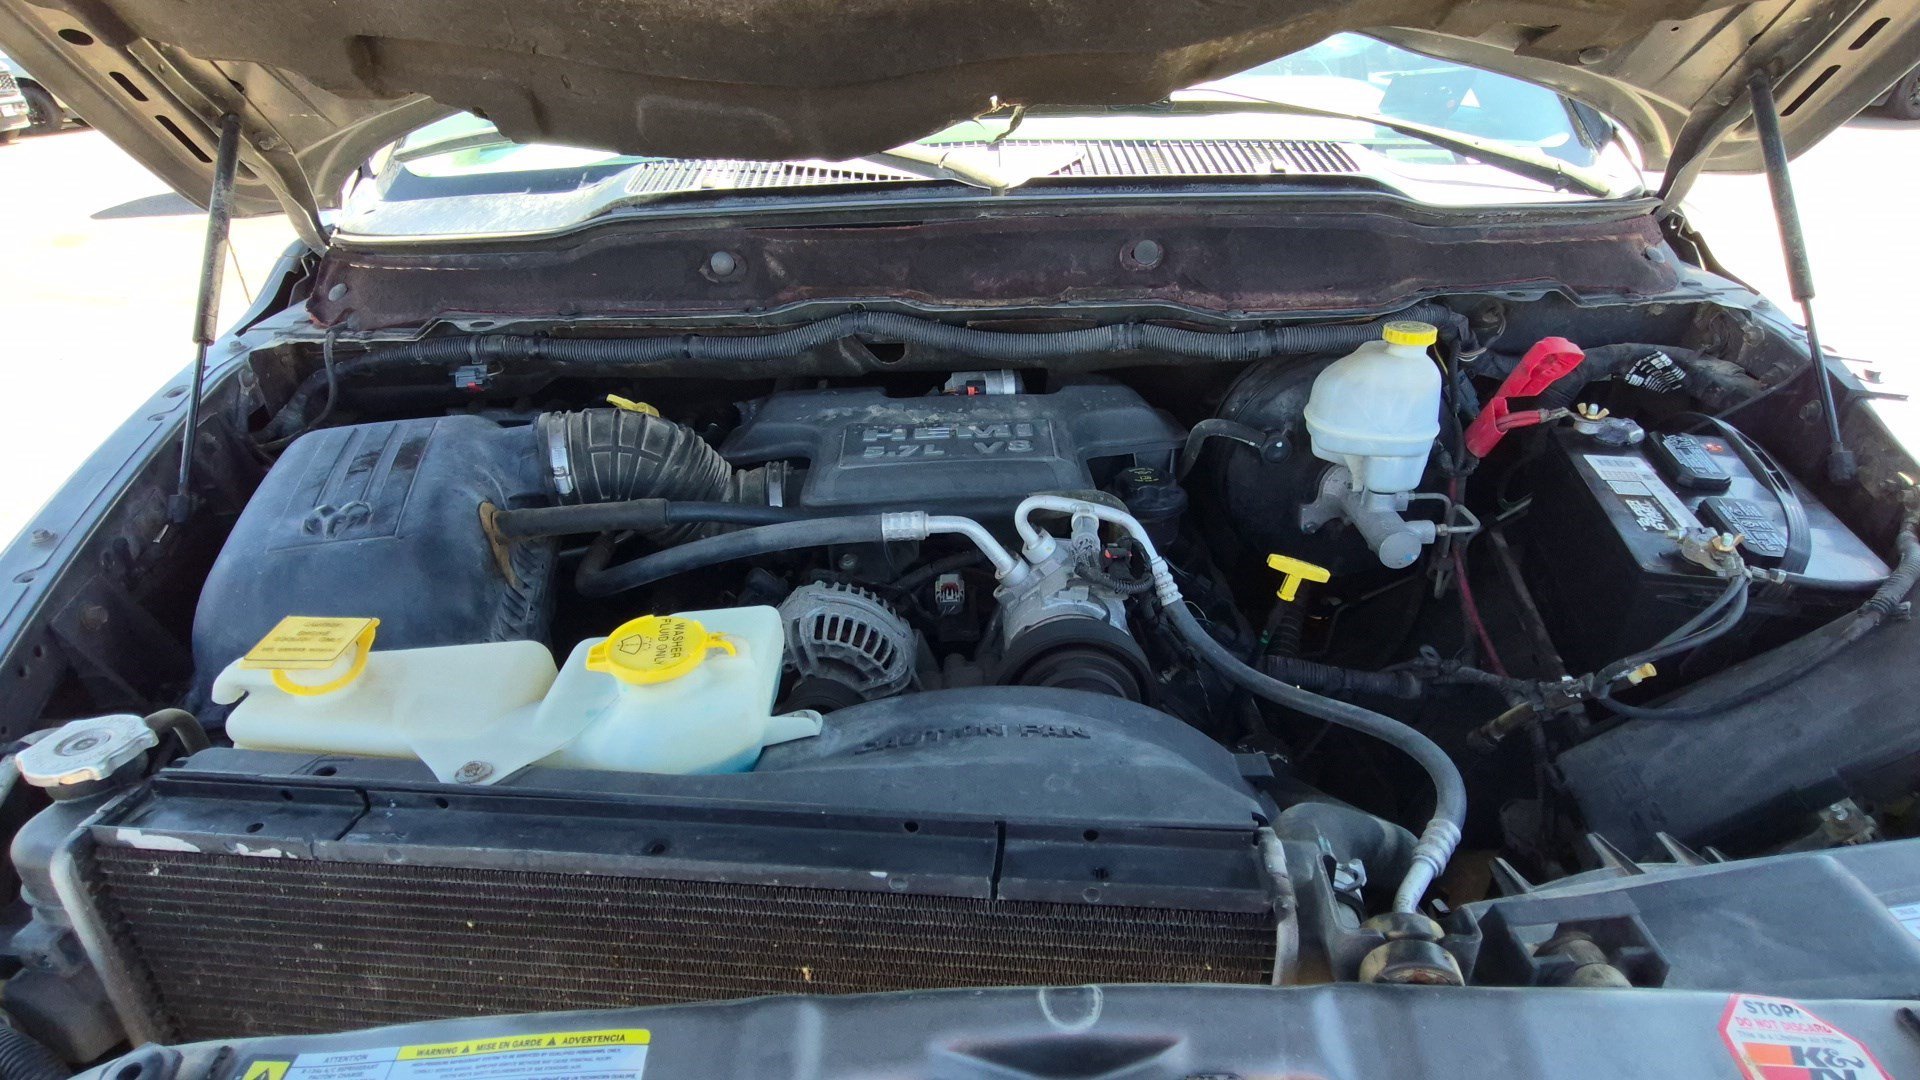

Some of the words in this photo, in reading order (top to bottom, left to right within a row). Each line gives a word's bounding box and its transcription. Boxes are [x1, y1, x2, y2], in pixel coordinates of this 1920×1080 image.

[862, 422, 1034, 441] HEMI
[863, 443, 945, 458] 5.7L
[973, 439, 1034, 455] V8
[658, 618, 672, 642] FLUID
[670, 622, 685, 659] WASHER
[654, 643, 667, 665] ONLY
[1018, 722, 1091, 741] FAN
[1735, 1016, 1752, 1029] DO
[1754, 1018, 1776, 1031] NOT
[476, 1042, 496, 1051] MISE
[499, 1041, 510, 1049] EN
[512, 1038, 542, 1048] GARDE
[563, 1034, 626, 1045] ADVERTENCIA
[323, 1054, 368, 1063] ATTENTION
[416, 1046, 458, 1056] WARNING
